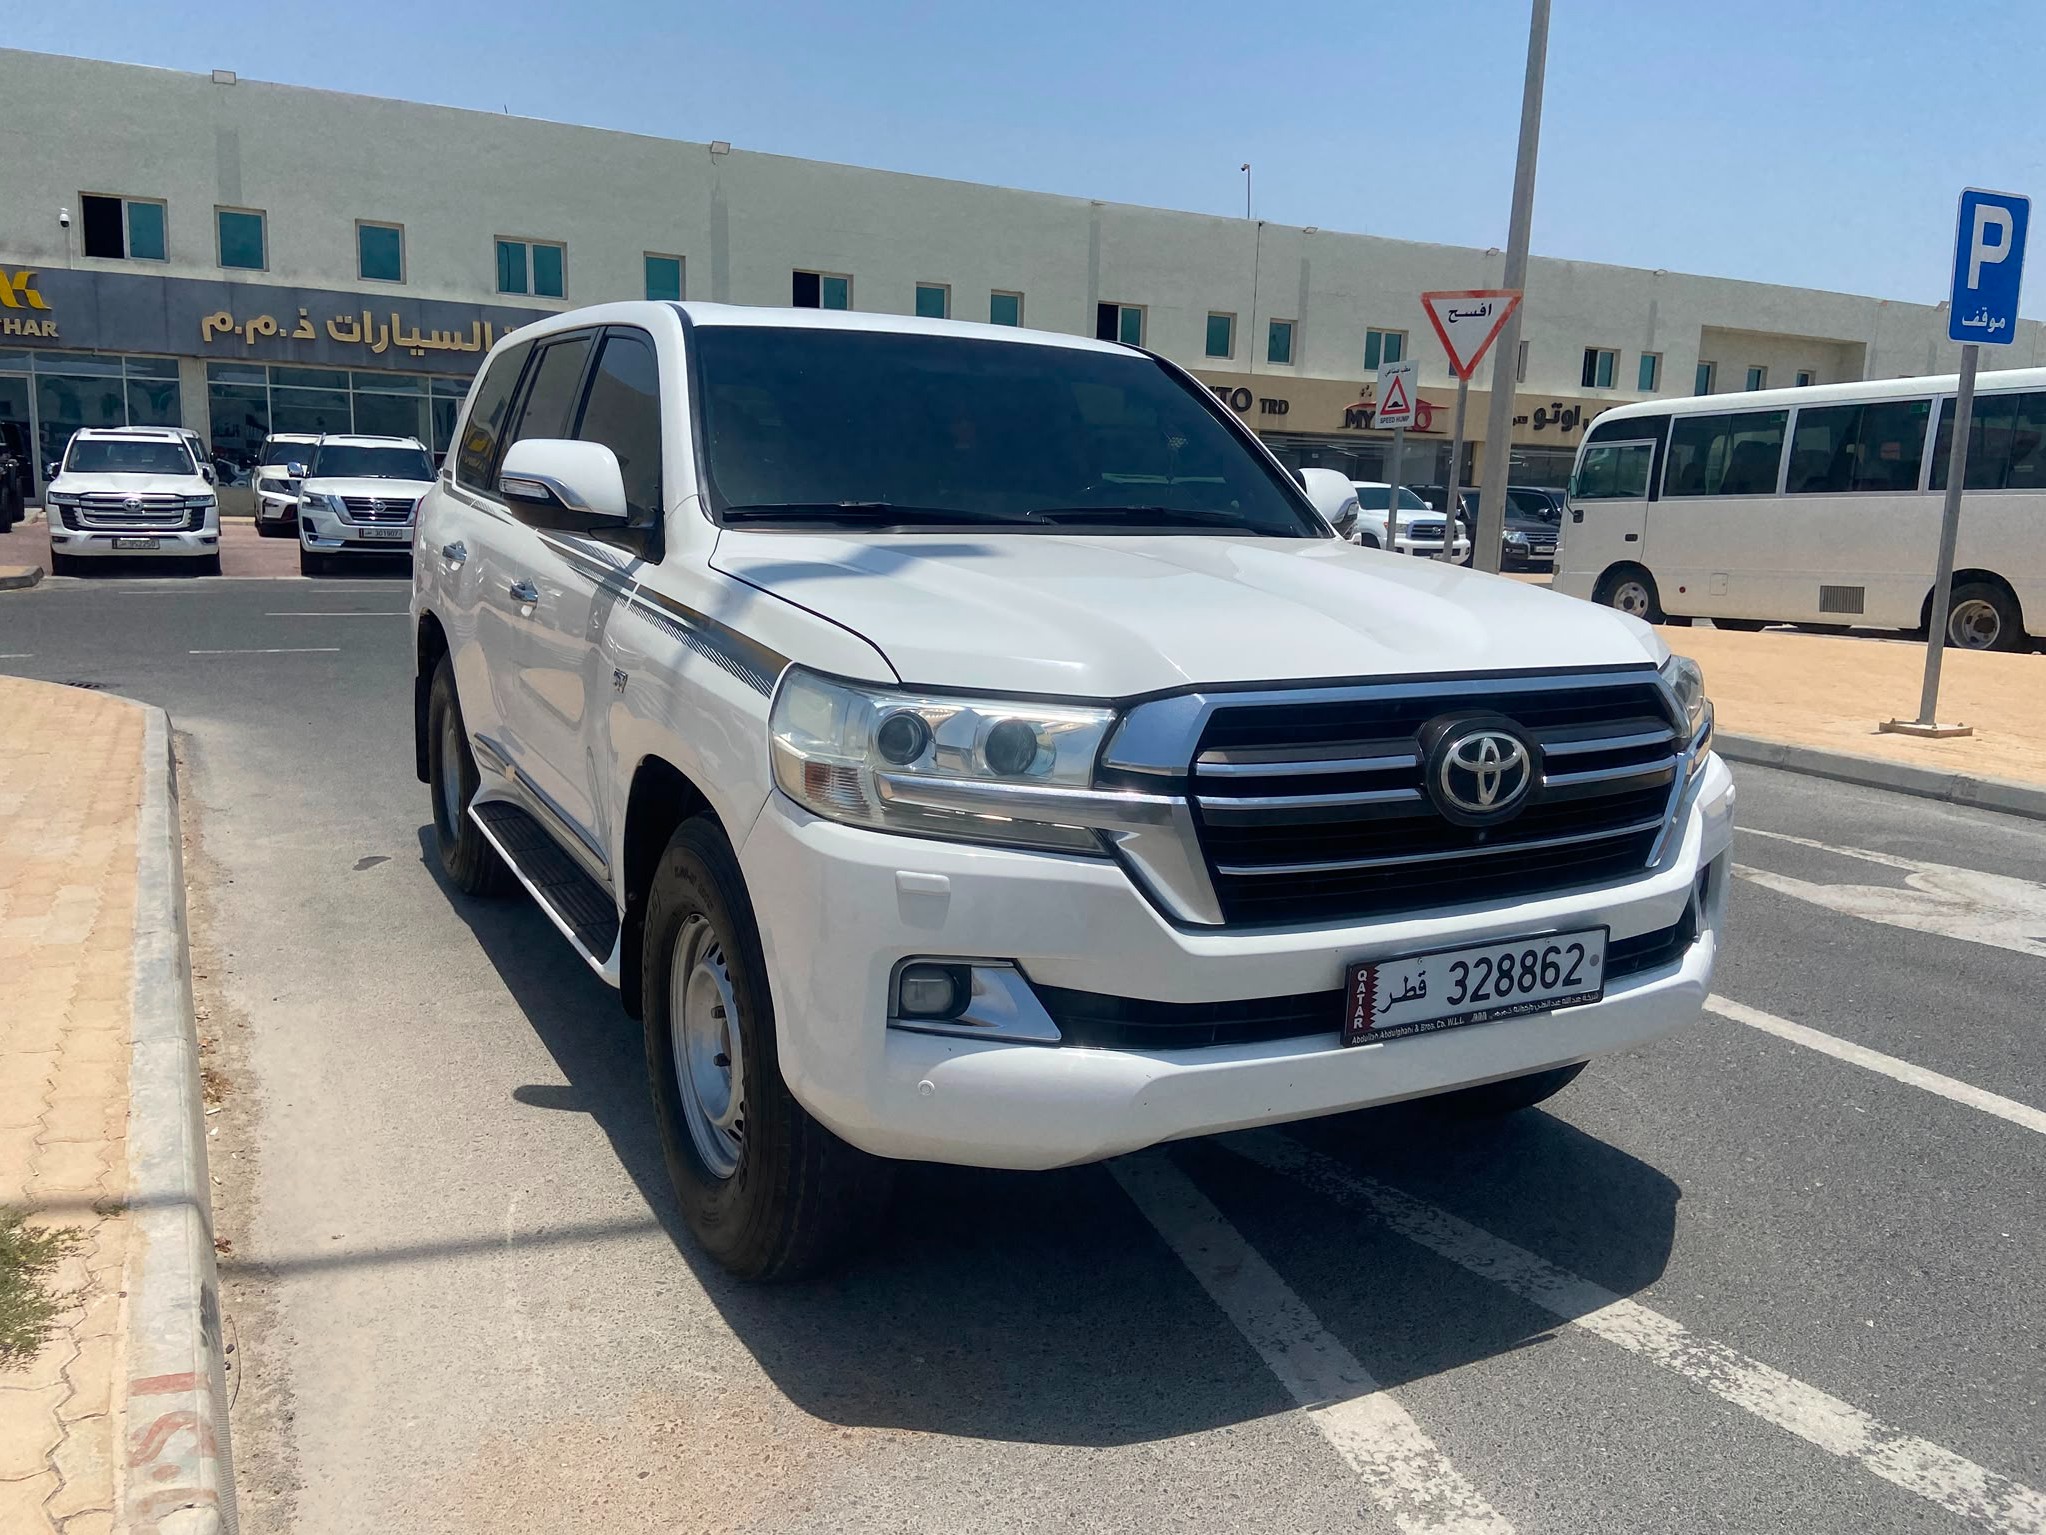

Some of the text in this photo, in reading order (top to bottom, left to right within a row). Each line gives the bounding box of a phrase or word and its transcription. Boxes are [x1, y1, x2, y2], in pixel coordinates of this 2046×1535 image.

[1967, 203, 2014, 290] P
[0, 317, 60, 338] HAR
[1448, 302, 1493, 324] افسح
[1961, 306, 2007, 333] موقف
[326, 309, 493, 356] السيارات
[1259, 398, 1290, 415] TRD
[1380, 415, 1410, 424] SPEED HUMP
[1376, 969, 1427, 1014] قطر
[1446, 942, 1586, 1006] 328862
[1353, 969, 1368, 1030] QATAR
